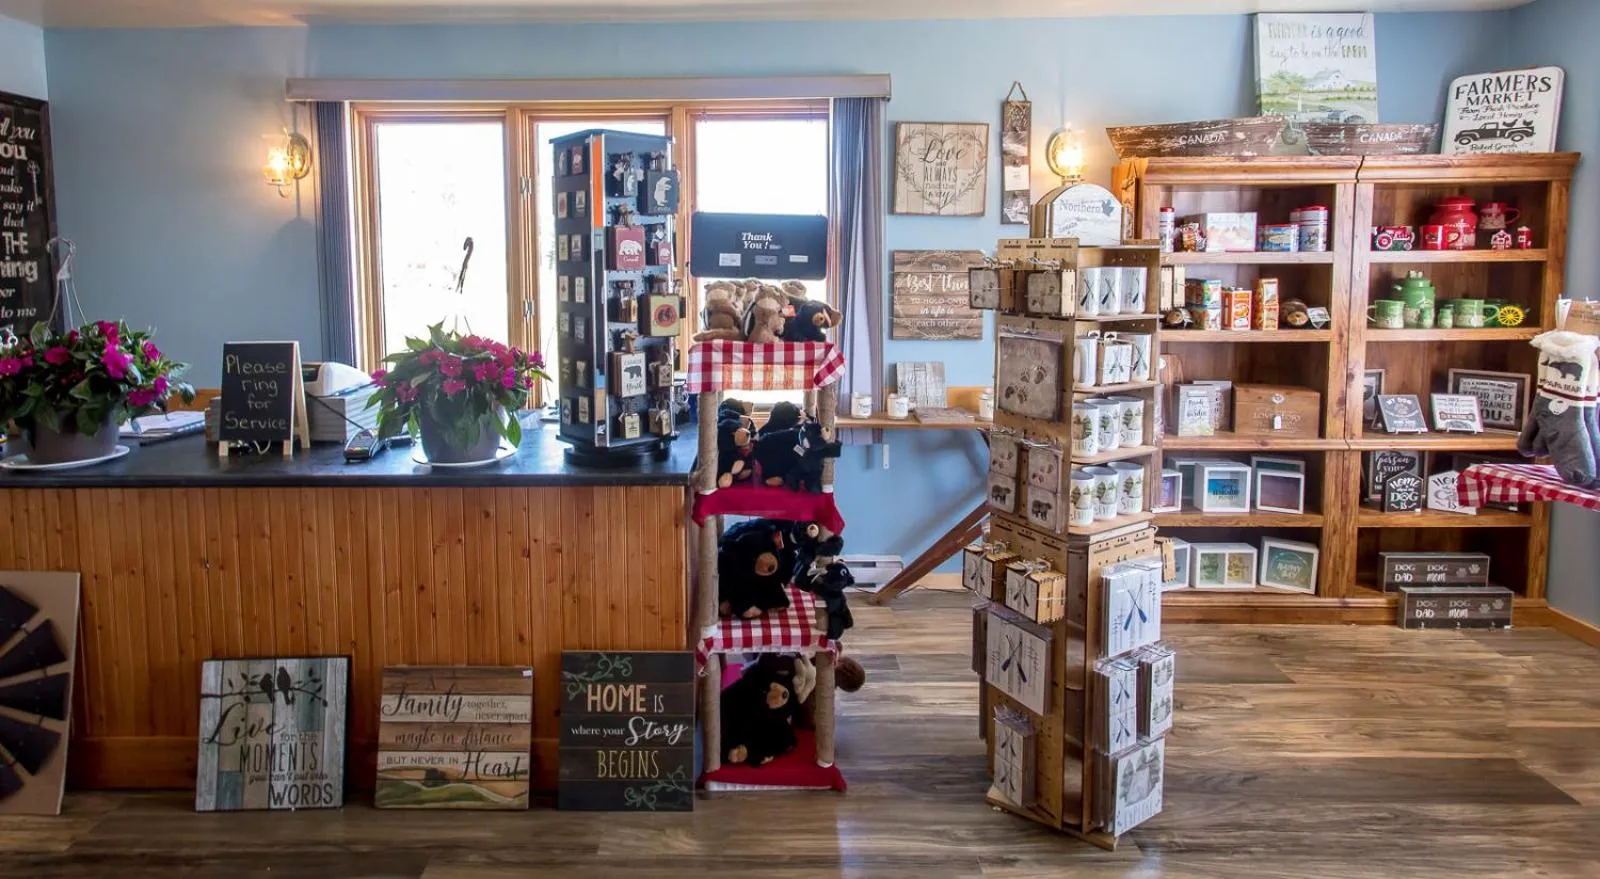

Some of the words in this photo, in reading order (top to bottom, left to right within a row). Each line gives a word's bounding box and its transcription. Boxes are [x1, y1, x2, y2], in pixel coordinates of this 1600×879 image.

[1311, 24, 1322, 38] is
[1336, 14, 1366, 43] good
[1455, 74, 1552, 100] FARMERS
[1466, 91, 1533, 106] MARKET
[8, 126, 35, 142] you
[1178, 134, 1226, 144] CANADA
[1359, 132, 1403, 143] CANADA
[0, 143, 28, 161] ou
[0, 165, 14, 176] nd
[3, 201, 23, 214] say
[2, 232, 28, 254] THE
[741, 232, 773, 242] Thank
[743, 241, 762, 250] You
[906, 273, 933, 293] Best
[941, 273, 970, 293] Thin
[1, 306, 13, 319] to
[917, 319, 935, 327] each
[937, 318, 959, 327] other
[225, 354, 288, 376] Please
[241, 380, 279, 398] ring
[247, 393, 272, 410] for
[1494, 393, 1513, 403] PET
[224, 410, 288, 430] Service
[1479, 408, 1502, 420] OU
[1390, 491, 1419, 502] DOG
[1394, 563, 1416, 572] DOG
[1426, 563, 1448, 572] DOG
[1394, 573, 1413, 582] DAD
[1415, 600, 1438, 608] DOG
[1448, 600, 1471, 608] DOG
[1415, 608, 1435, 618] DAD
[381, 680, 464, 723] Family
[587, 683, 648, 713] HOME
[653, 694, 665, 713] IS
[203, 702, 286, 746] Live
[571, 725, 601, 736] where
[602, 728, 626, 738] your
[624, 716, 689, 747] Story
[280, 732, 297, 743] for
[239, 742, 320, 774] MOMENTS
[386, 756, 407, 765] BUT
[410, 756, 445, 765] NEVER
[449, 756, 459, 765] IN
[461, 748, 527, 781] Heart
[596, 750, 660, 779] BEGINS
[270, 782, 334, 806] WORDS
